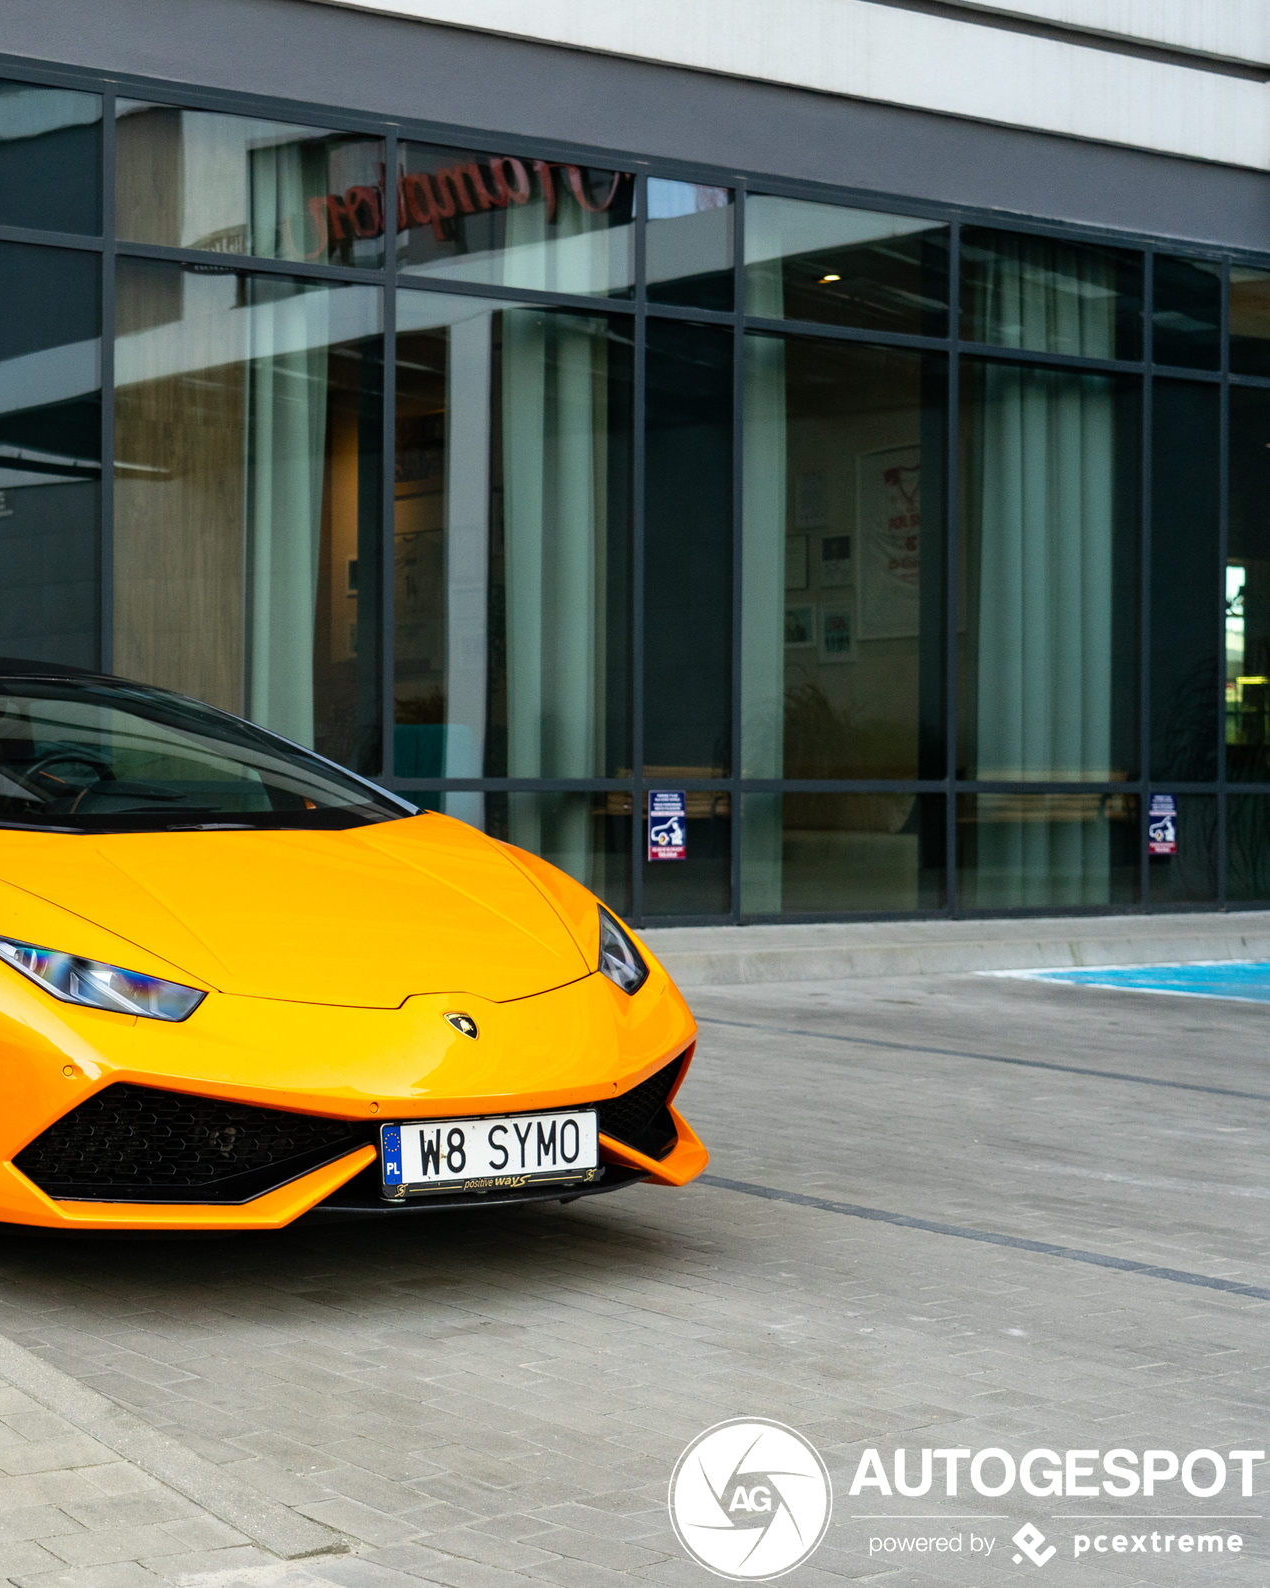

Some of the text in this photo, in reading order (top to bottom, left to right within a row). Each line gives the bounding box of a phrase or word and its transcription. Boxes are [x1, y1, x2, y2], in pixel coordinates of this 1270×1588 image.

[419, 1119, 580, 1176] W8 SYMO
[386, 1162, 401, 1176] PL
[463, 1174, 532, 1191] positive ways
